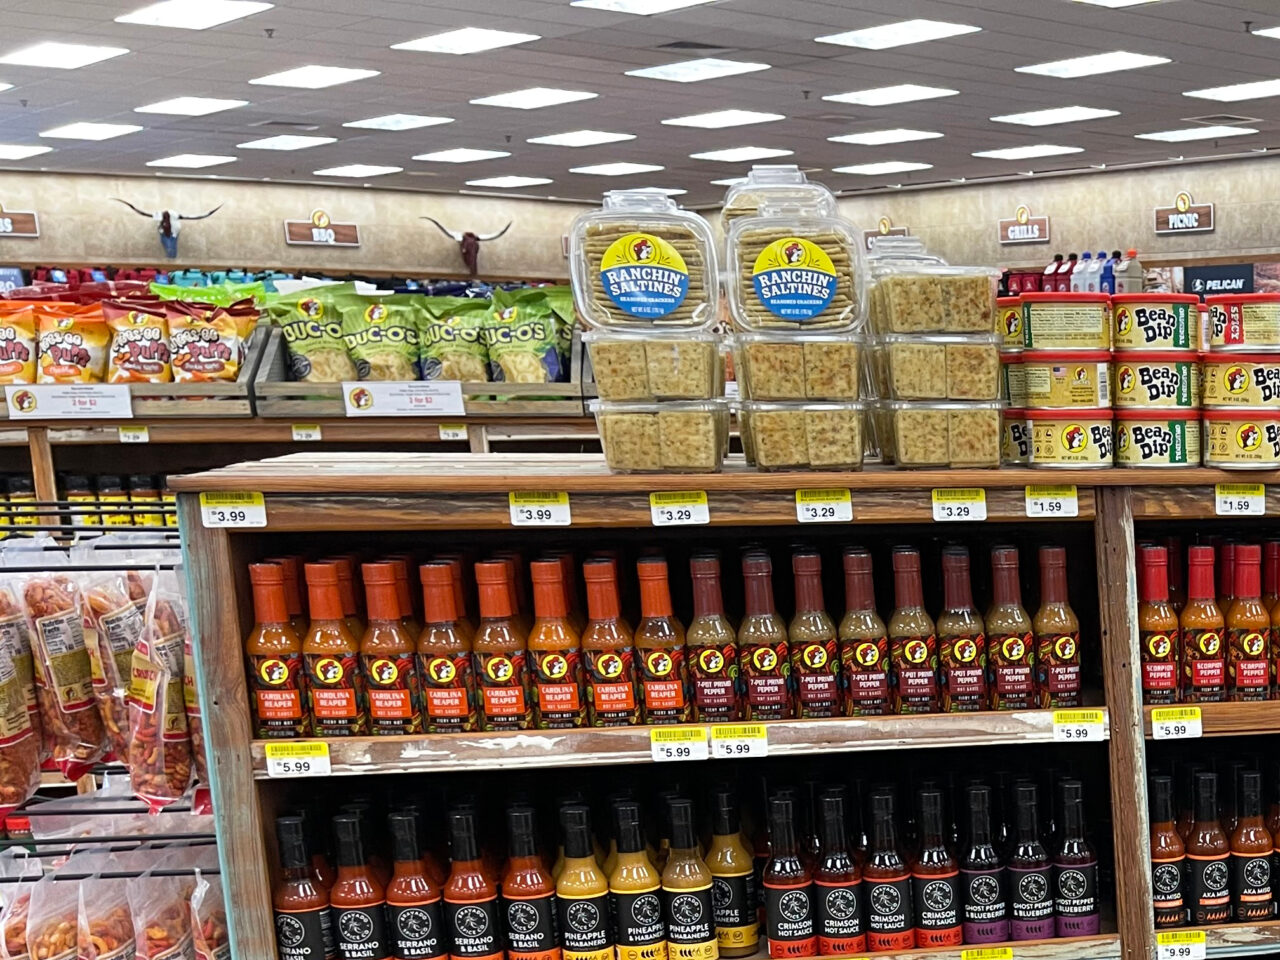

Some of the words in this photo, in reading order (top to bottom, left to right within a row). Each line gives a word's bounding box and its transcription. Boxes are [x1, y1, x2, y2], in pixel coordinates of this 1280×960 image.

[1168, 213, 1199, 229] PICNIC
[312, 228, 335, 242] BBQ
[606, 268, 685, 286] RANCHIN'
[758, 269, 833, 287] RANCHIN'
[1206, 279, 1244, 290] PELICAN
[609, 282, 682, 298] SALTINES
[761, 283, 830, 299] SALTINES
[1135, 307, 1176, 327] Bean
[1231, 306, 1239, 341] SPICY
[1143, 323, 1173, 343] Dip
[129, 341, 171, 364] Puffs
[1146, 664, 1174, 672] SCORPION
[1004, 674, 1025, 683] PEPPER
[260, 692, 296, 701] CAROLINA
[429, 690, 464, 699] CAROLINA
[703, 687, 726, 696] PEPPER
[264, 699, 294, 709] REAPER
[433, 697, 460, 707] REAPER
[1256, 886, 1271, 895] MISO
[965, 904, 983, 913] GHOST
[984, 902, 1005, 911] PEPPER
[922, 910, 956, 920] CRIMSON
[824, 917, 860, 928] CRIMSON
[922, 918, 937, 926] HOT
[938, 916, 956, 925] SAUCE
[564, 930, 606, 940] PINEAPPLE
[825, 926, 840, 935] HOT
[841, 925, 859, 934] SAUCE
[398, 938, 437, 949] SERRANO
[454, 936, 493, 947] SERRANO
[565, 939, 570, 947] &
[571, 937, 606, 947] HABANERO
[403, 948, 409, 956] &
[410, 946, 433, 956] BASIL
[460, 946, 466, 954] &
[467, 944, 488, 953] BASIL
